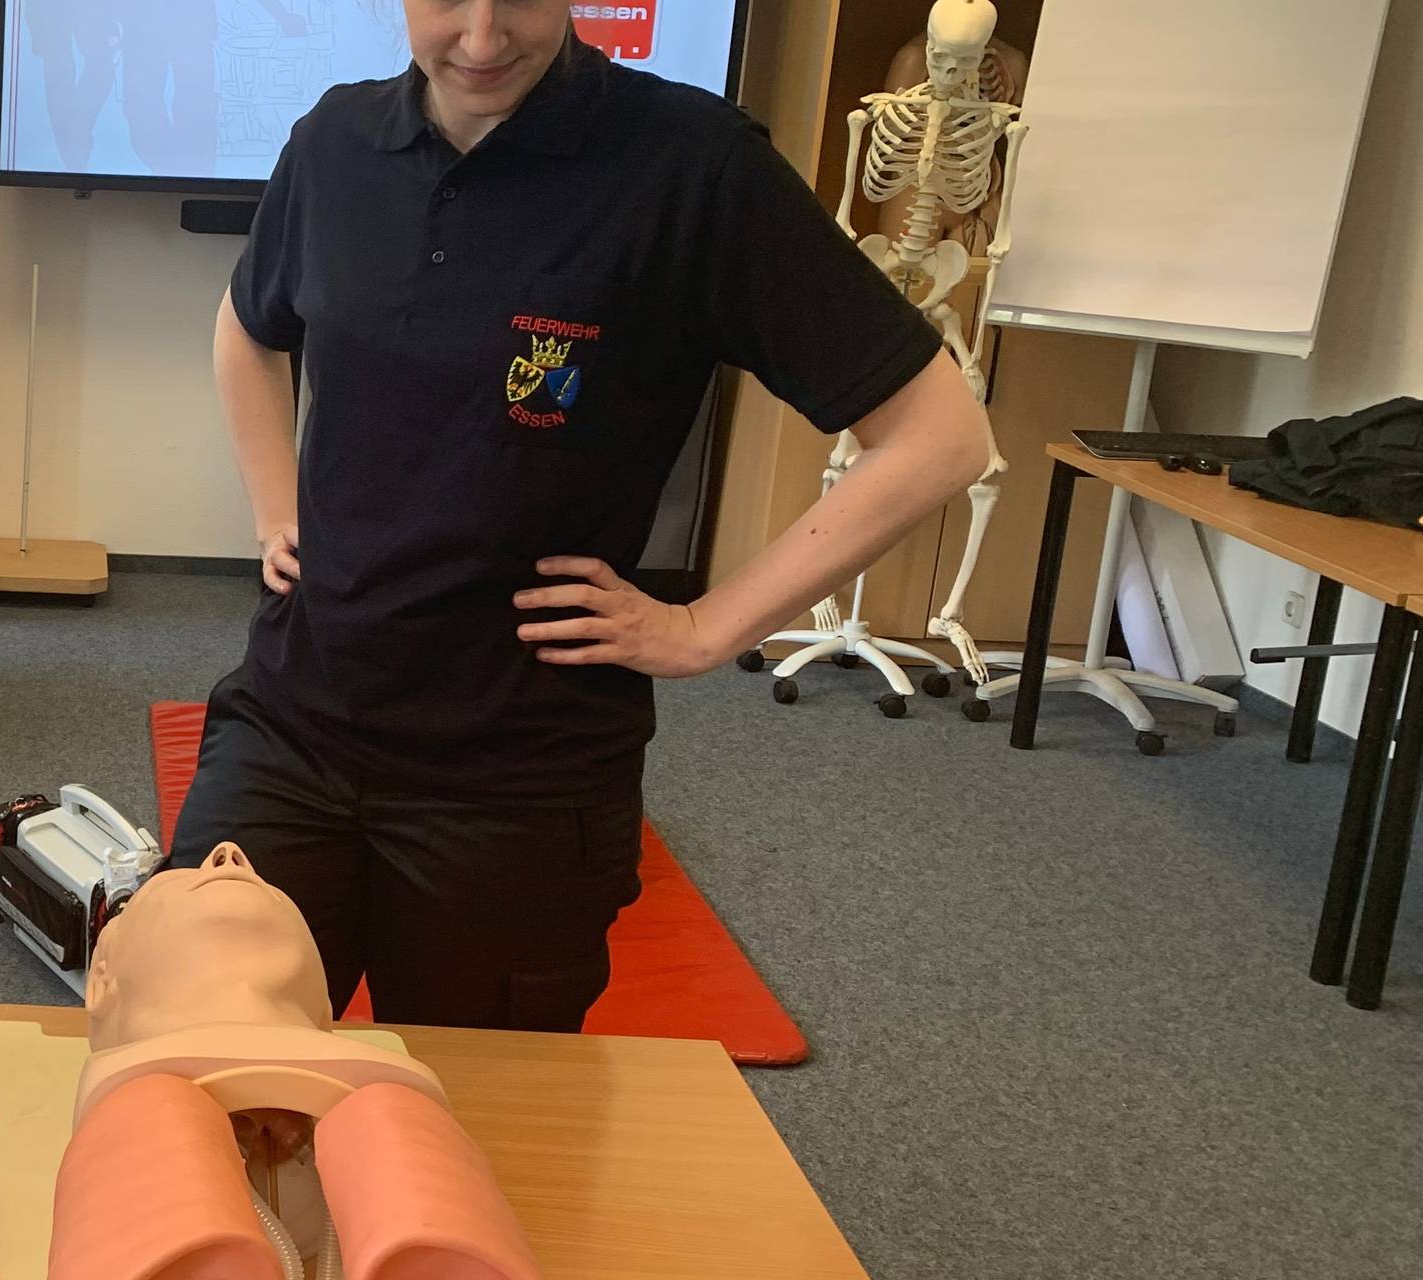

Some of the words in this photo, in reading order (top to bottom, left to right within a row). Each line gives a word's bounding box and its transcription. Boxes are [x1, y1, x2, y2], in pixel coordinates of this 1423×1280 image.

[569, 5, 648, 20] essen
[511, 315, 601, 340] FEUERWEHR
[508, 403, 566, 428] ESSEN
